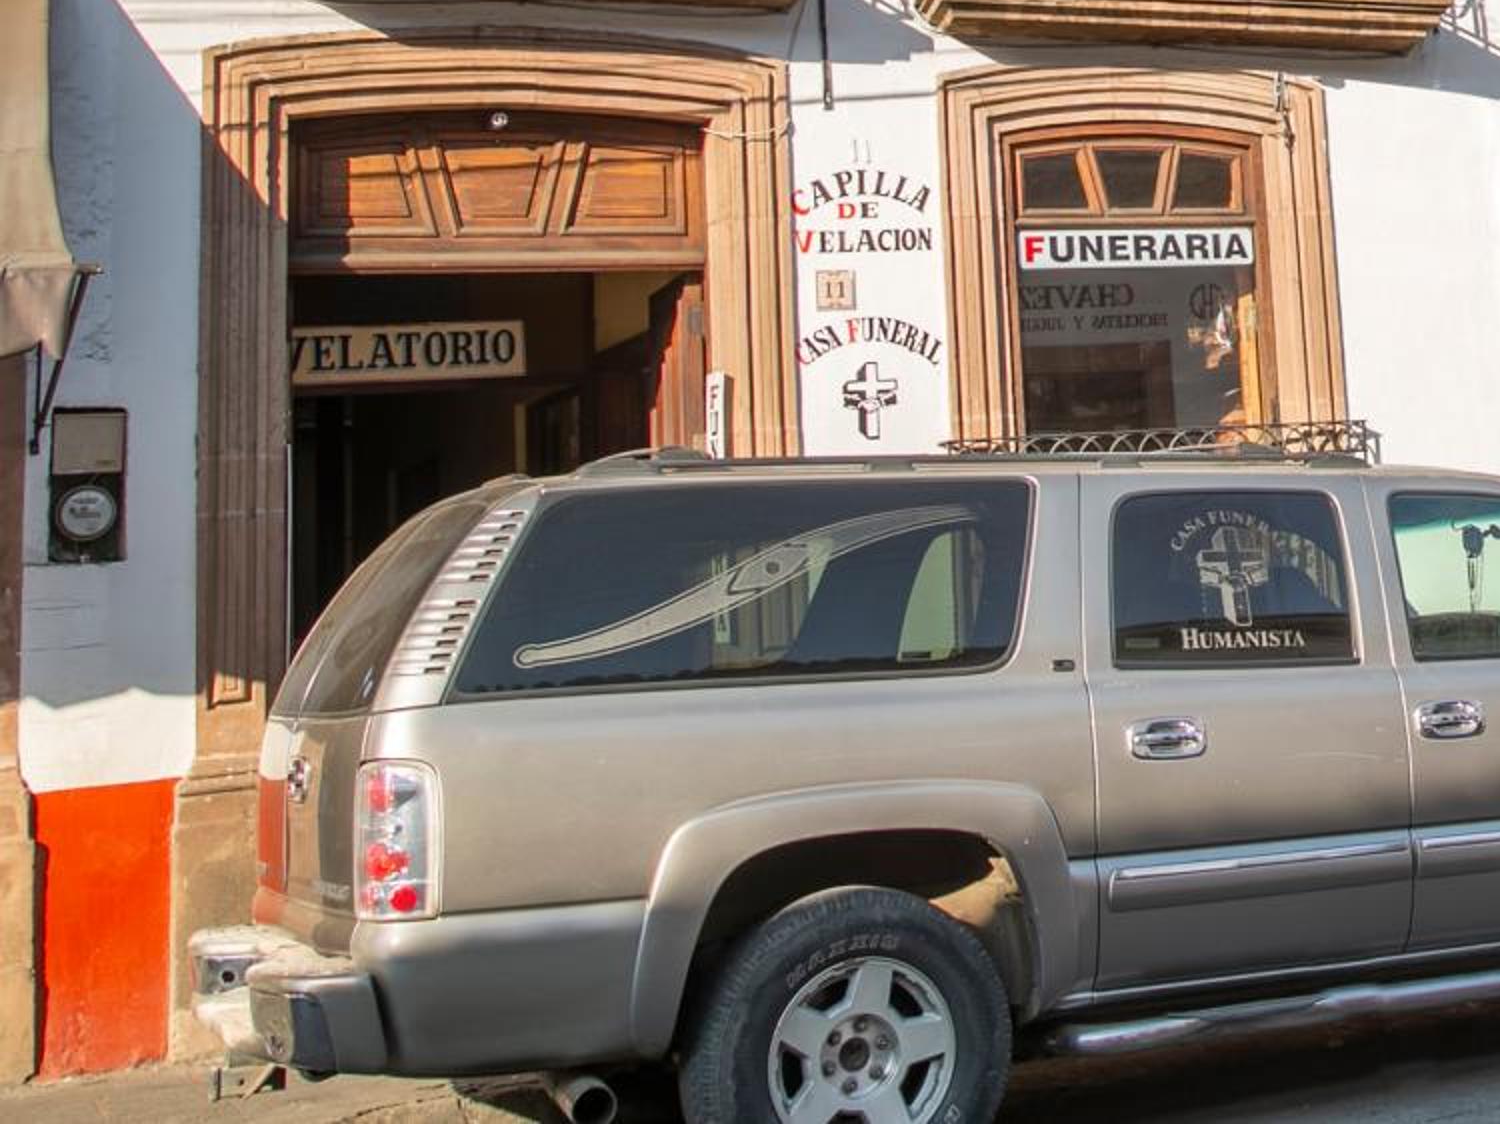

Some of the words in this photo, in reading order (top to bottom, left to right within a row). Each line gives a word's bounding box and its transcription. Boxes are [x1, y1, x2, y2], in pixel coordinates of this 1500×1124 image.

[790, 169, 932, 217] CAPILLA
[838, 201, 879, 219] DE
[793, 228, 933, 253] VELACION
[1024, 233, 1249, 263] FUNERARIA
[795, 326, 843, 366] CASA
[846, 317, 943, 365] FUNERAL
[1171, 517, 1206, 551] CASA
[1180, 627, 1306, 650] HUMANISTA
